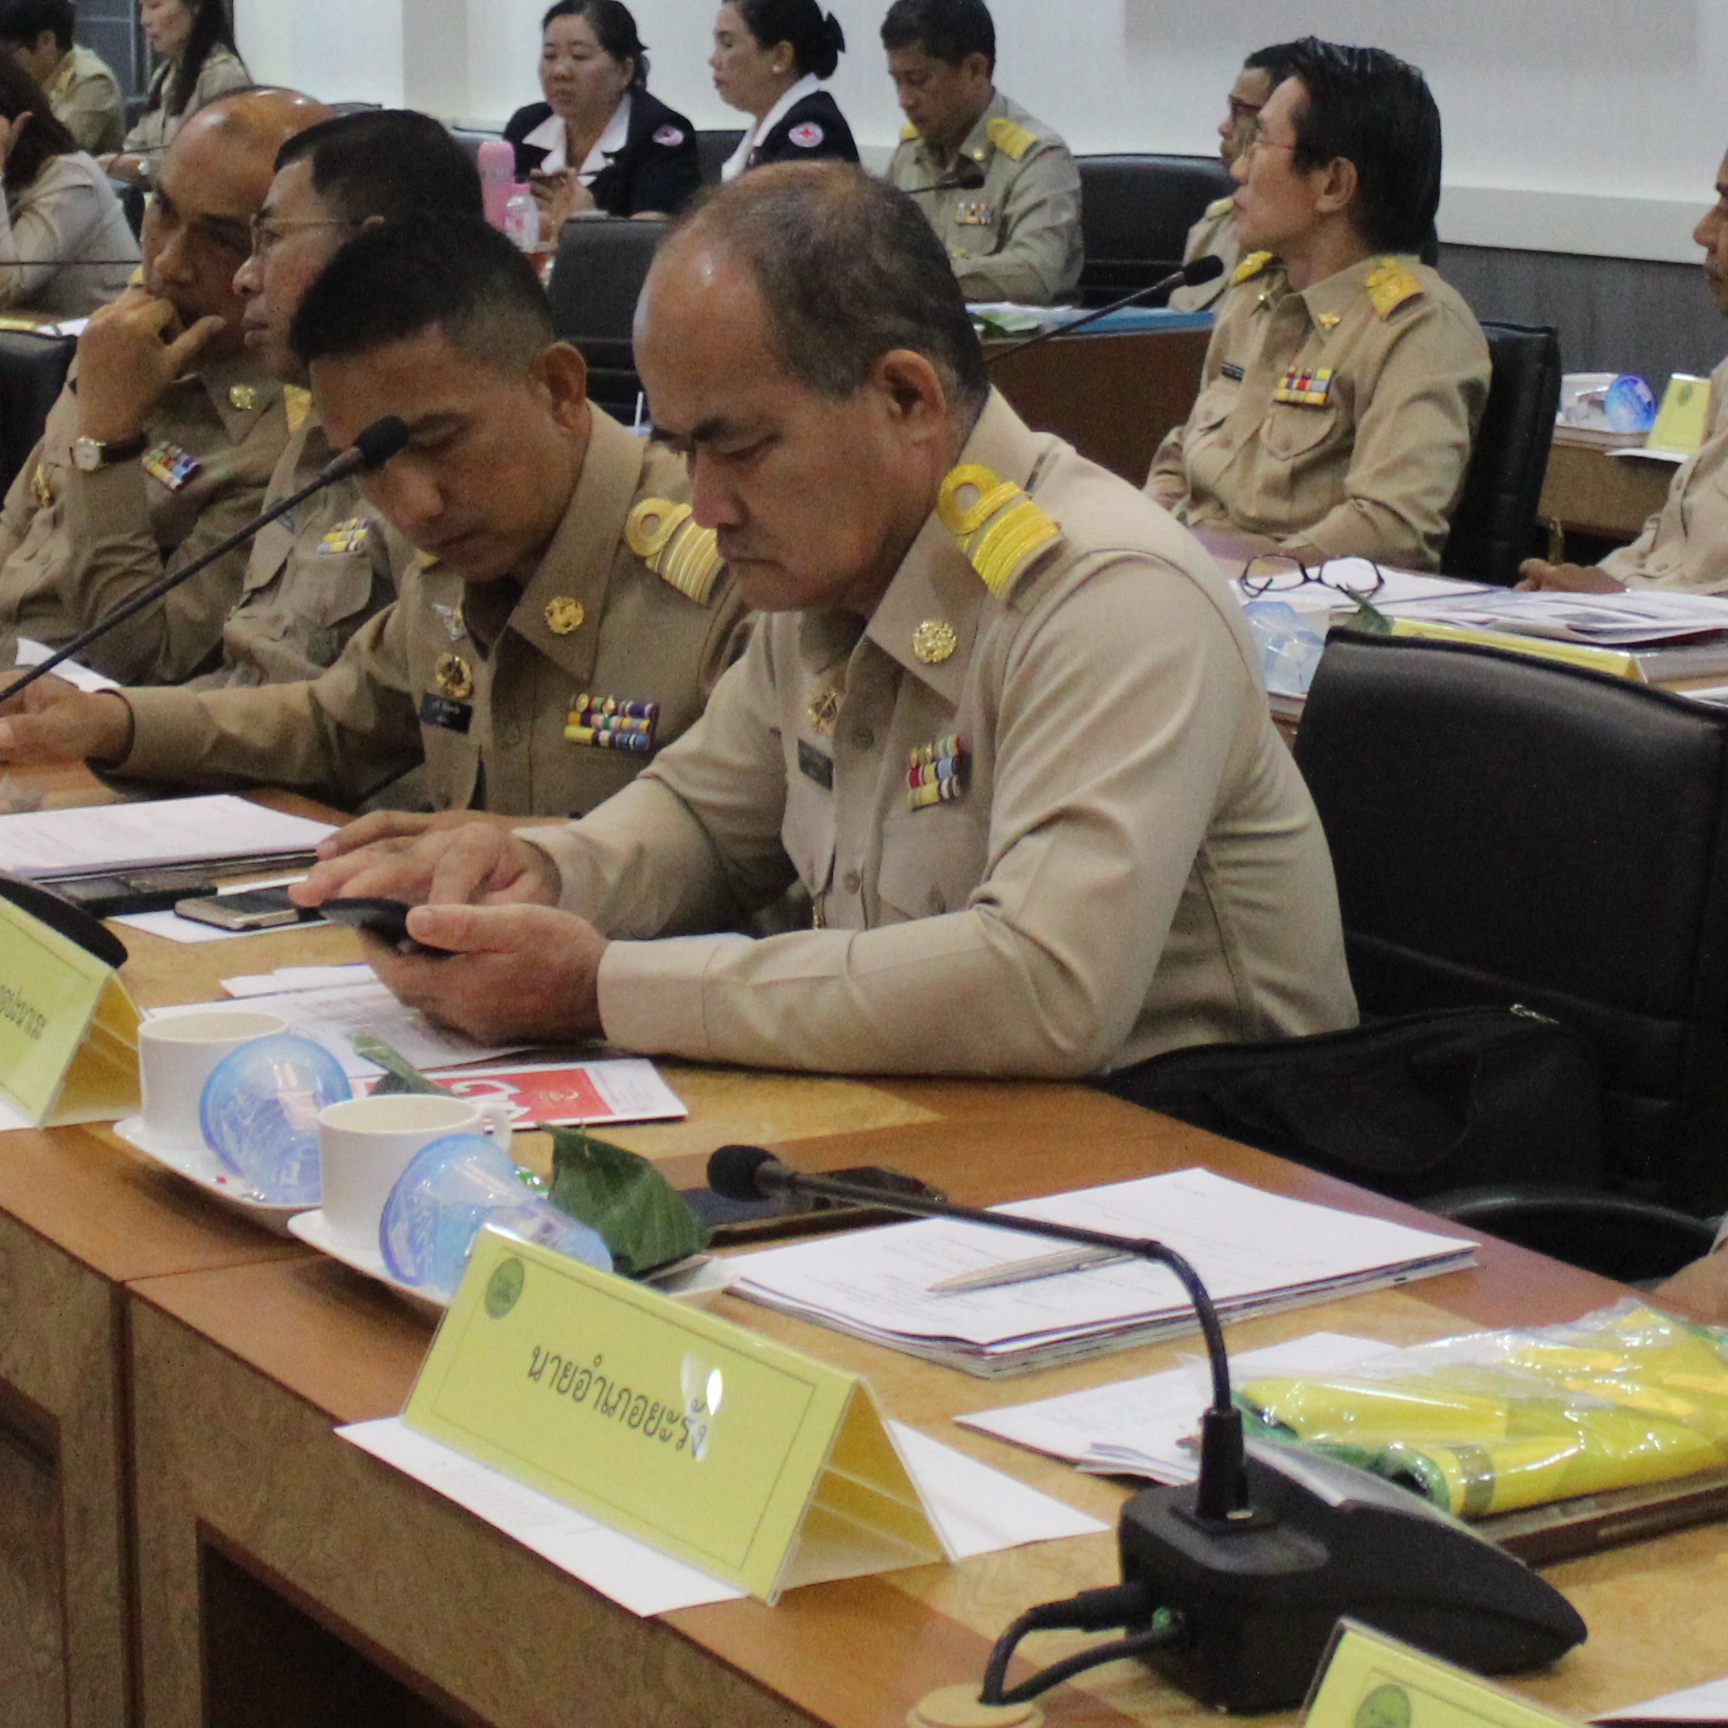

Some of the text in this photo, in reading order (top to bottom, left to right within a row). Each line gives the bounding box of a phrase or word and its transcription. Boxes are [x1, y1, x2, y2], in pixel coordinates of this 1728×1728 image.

[525, 1345, 709, 1456] นายอำเภอยะรัง
